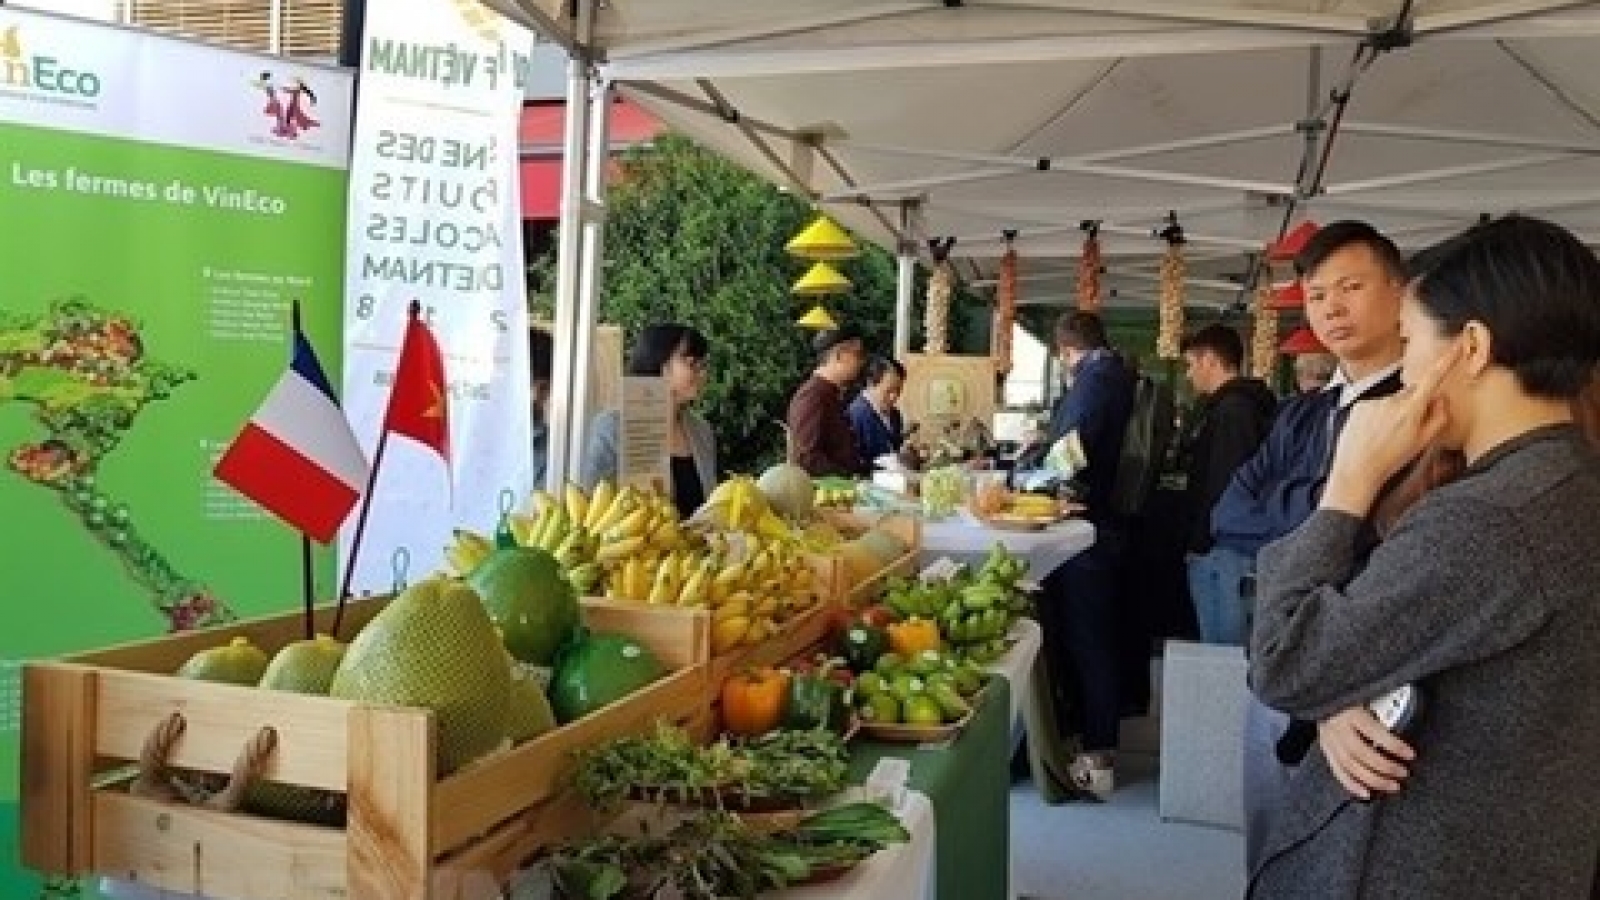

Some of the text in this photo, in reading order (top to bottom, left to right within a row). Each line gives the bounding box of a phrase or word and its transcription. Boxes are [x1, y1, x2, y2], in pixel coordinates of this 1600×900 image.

[3, 55, 101, 97] nEco
[11, 162, 287, 215] Les fermes de VinEco
